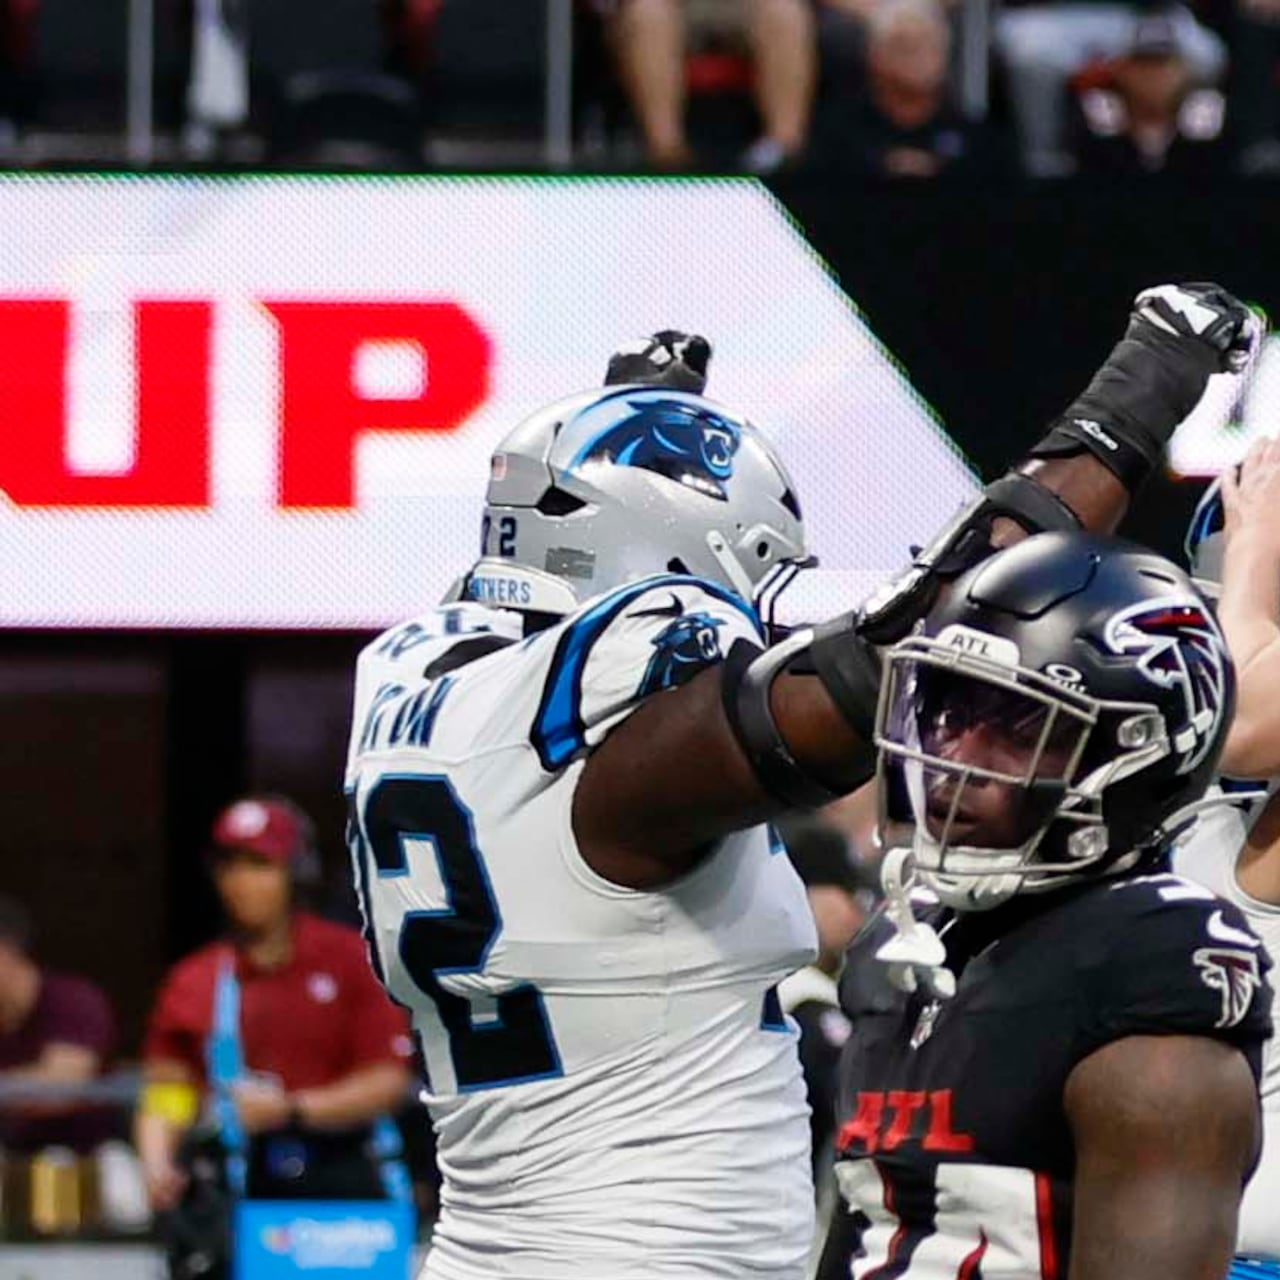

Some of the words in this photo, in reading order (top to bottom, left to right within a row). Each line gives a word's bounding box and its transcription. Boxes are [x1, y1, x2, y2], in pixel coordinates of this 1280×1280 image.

[0, 297, 494, 509] UP
[951, 633, 992, 657] ATL
[834, 1088, 977, 1153] ATL
